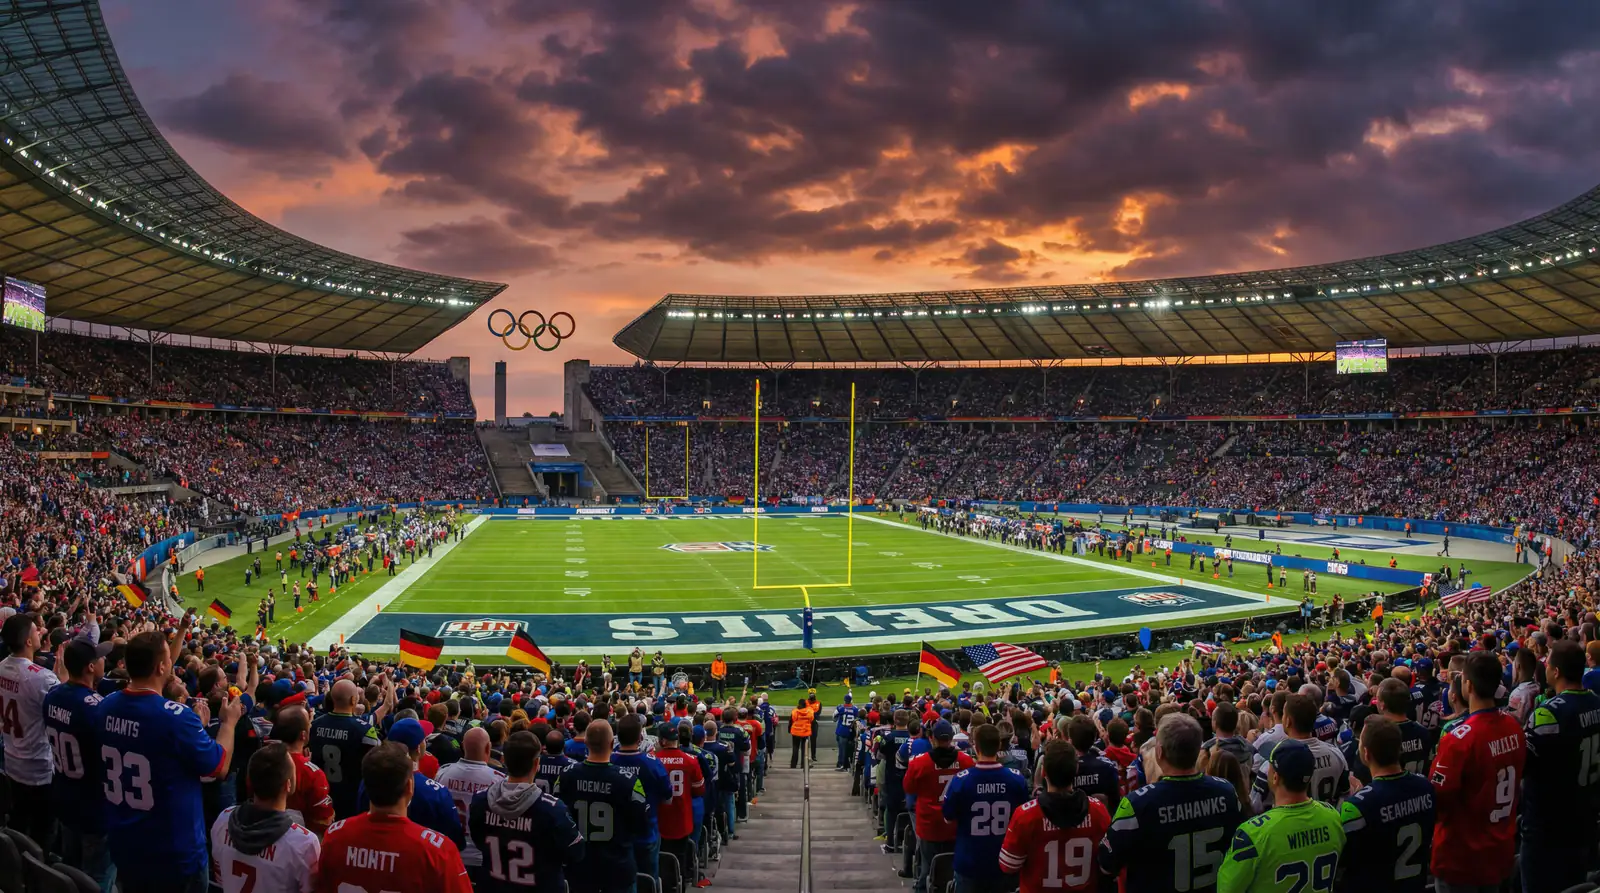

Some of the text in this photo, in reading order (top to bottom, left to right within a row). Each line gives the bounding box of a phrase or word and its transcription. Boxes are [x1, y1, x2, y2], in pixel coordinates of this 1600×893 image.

[451, 621, 516, 632] NFL
[105, 715, 140, 738] GIANTS
[841, 714, 855, 726] 12
[101, 745, 154, 811] 33
[322, 744, 343, 783] 8
[976, 782, 1006, 794] GIANTS
[573, 800, 615, 842] 19
[971, 801, 1011, 836] 28
[1158, 796, 1227, 824] SEAHAWKS
[1379, 793, 1433, 823] SEAHAWKS
[484, 835, 537, 887] 12
[1043, 838, 1093, 887] 19
[1168, 827, 1226, 892] 15
[1394, 822, 1423, 882] 2
[231, 860, 257, 893] 7
